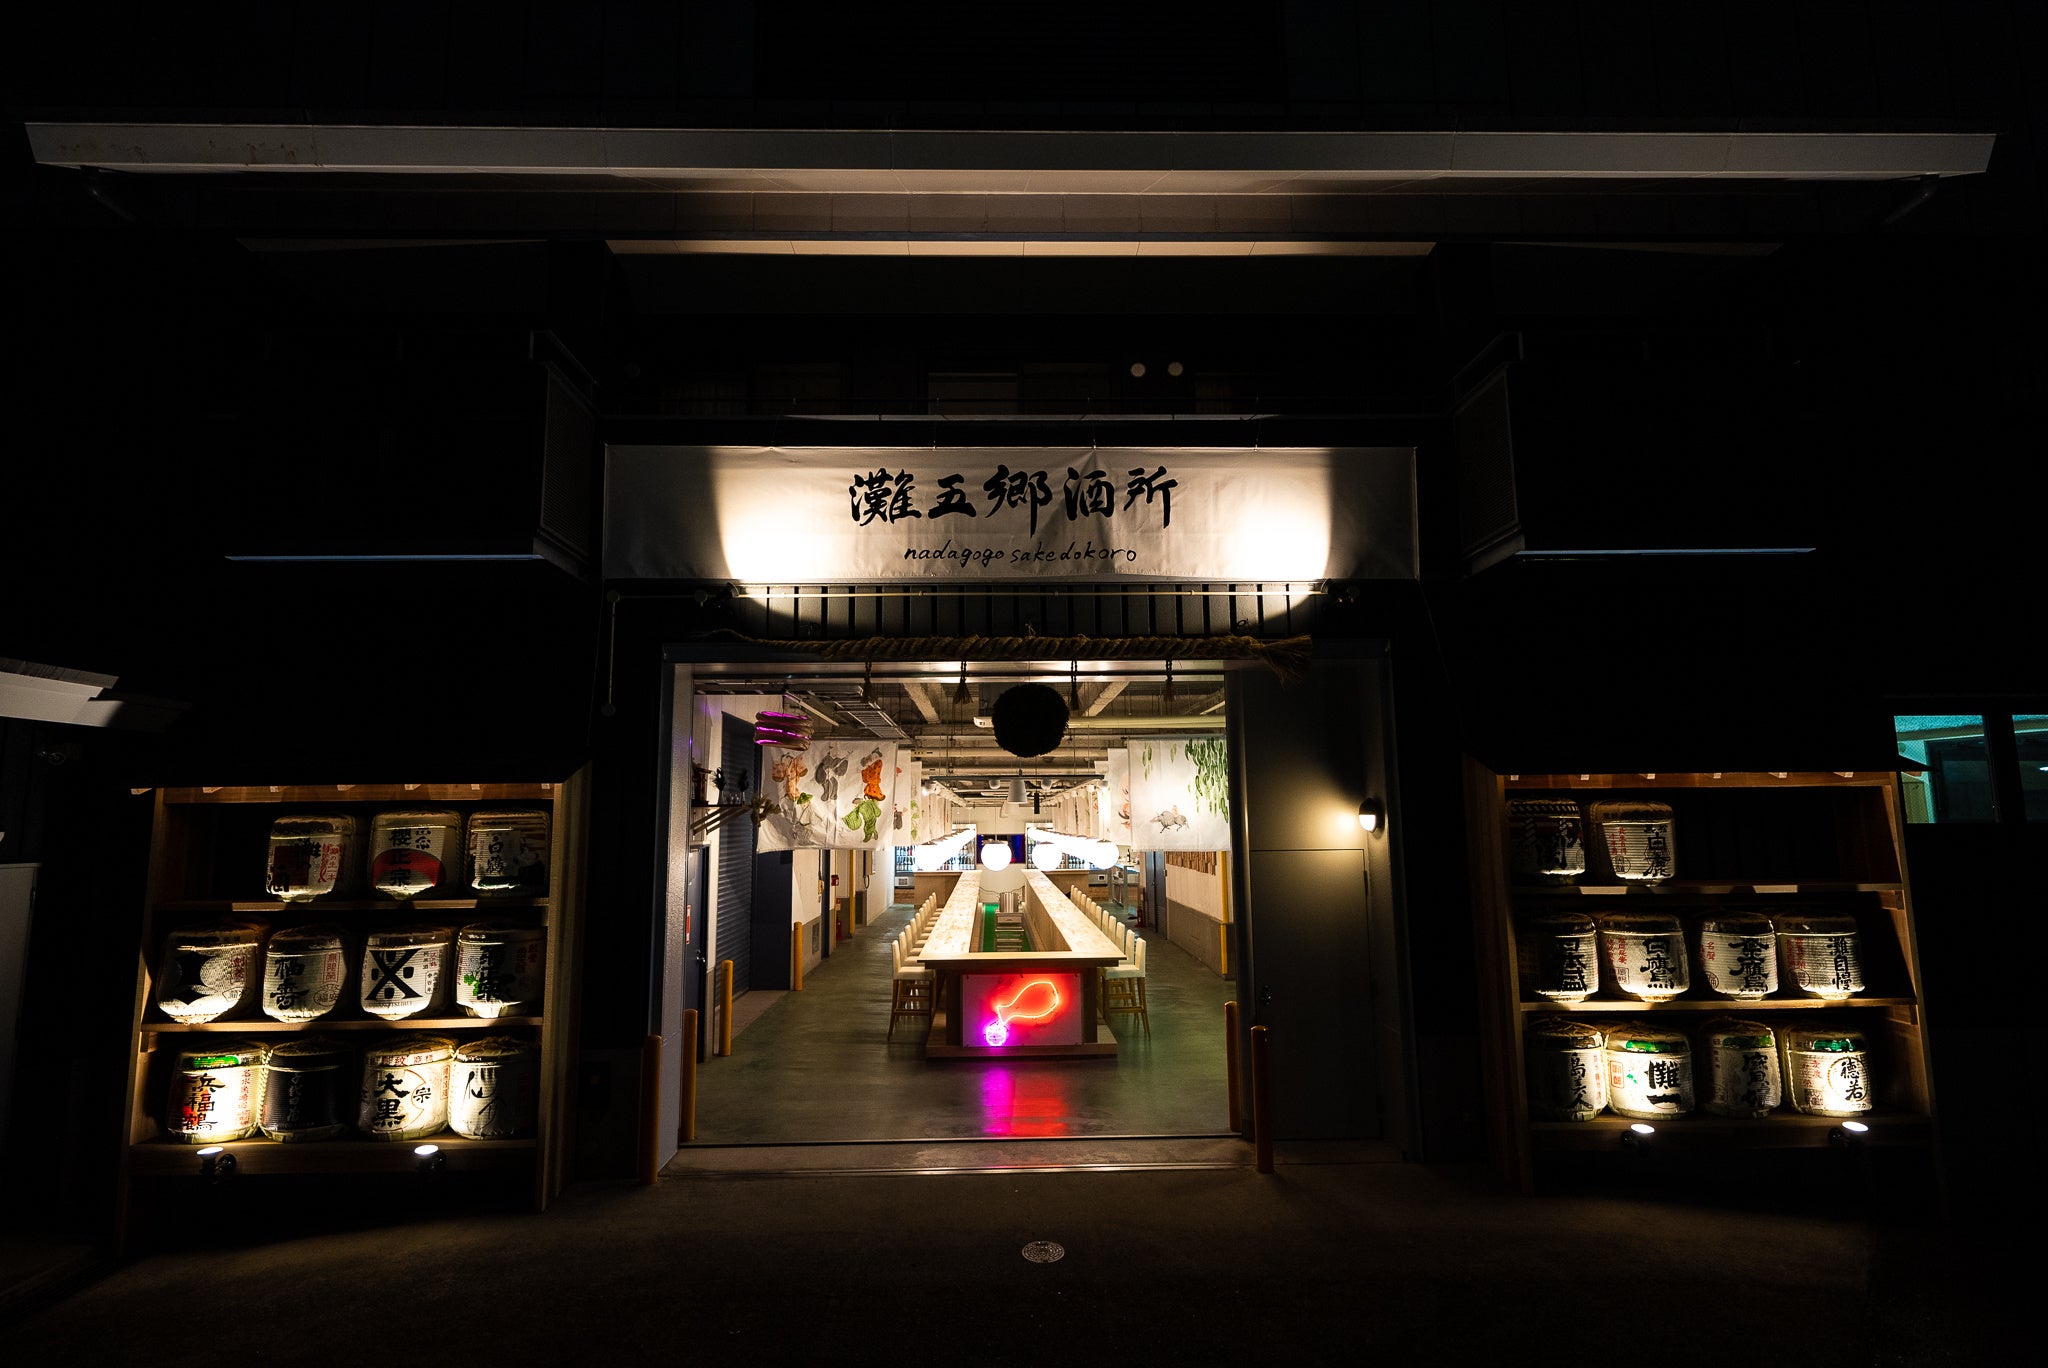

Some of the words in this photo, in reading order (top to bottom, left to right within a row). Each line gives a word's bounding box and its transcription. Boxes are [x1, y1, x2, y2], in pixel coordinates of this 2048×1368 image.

[849, 465, 1178, 538] 灘五郷酒所
[904, 539, 1004, 568] nadagogo
[1010, 541, 1138, 563] sakedokoro
[1640, 937, 1677, 989] 白鷹
